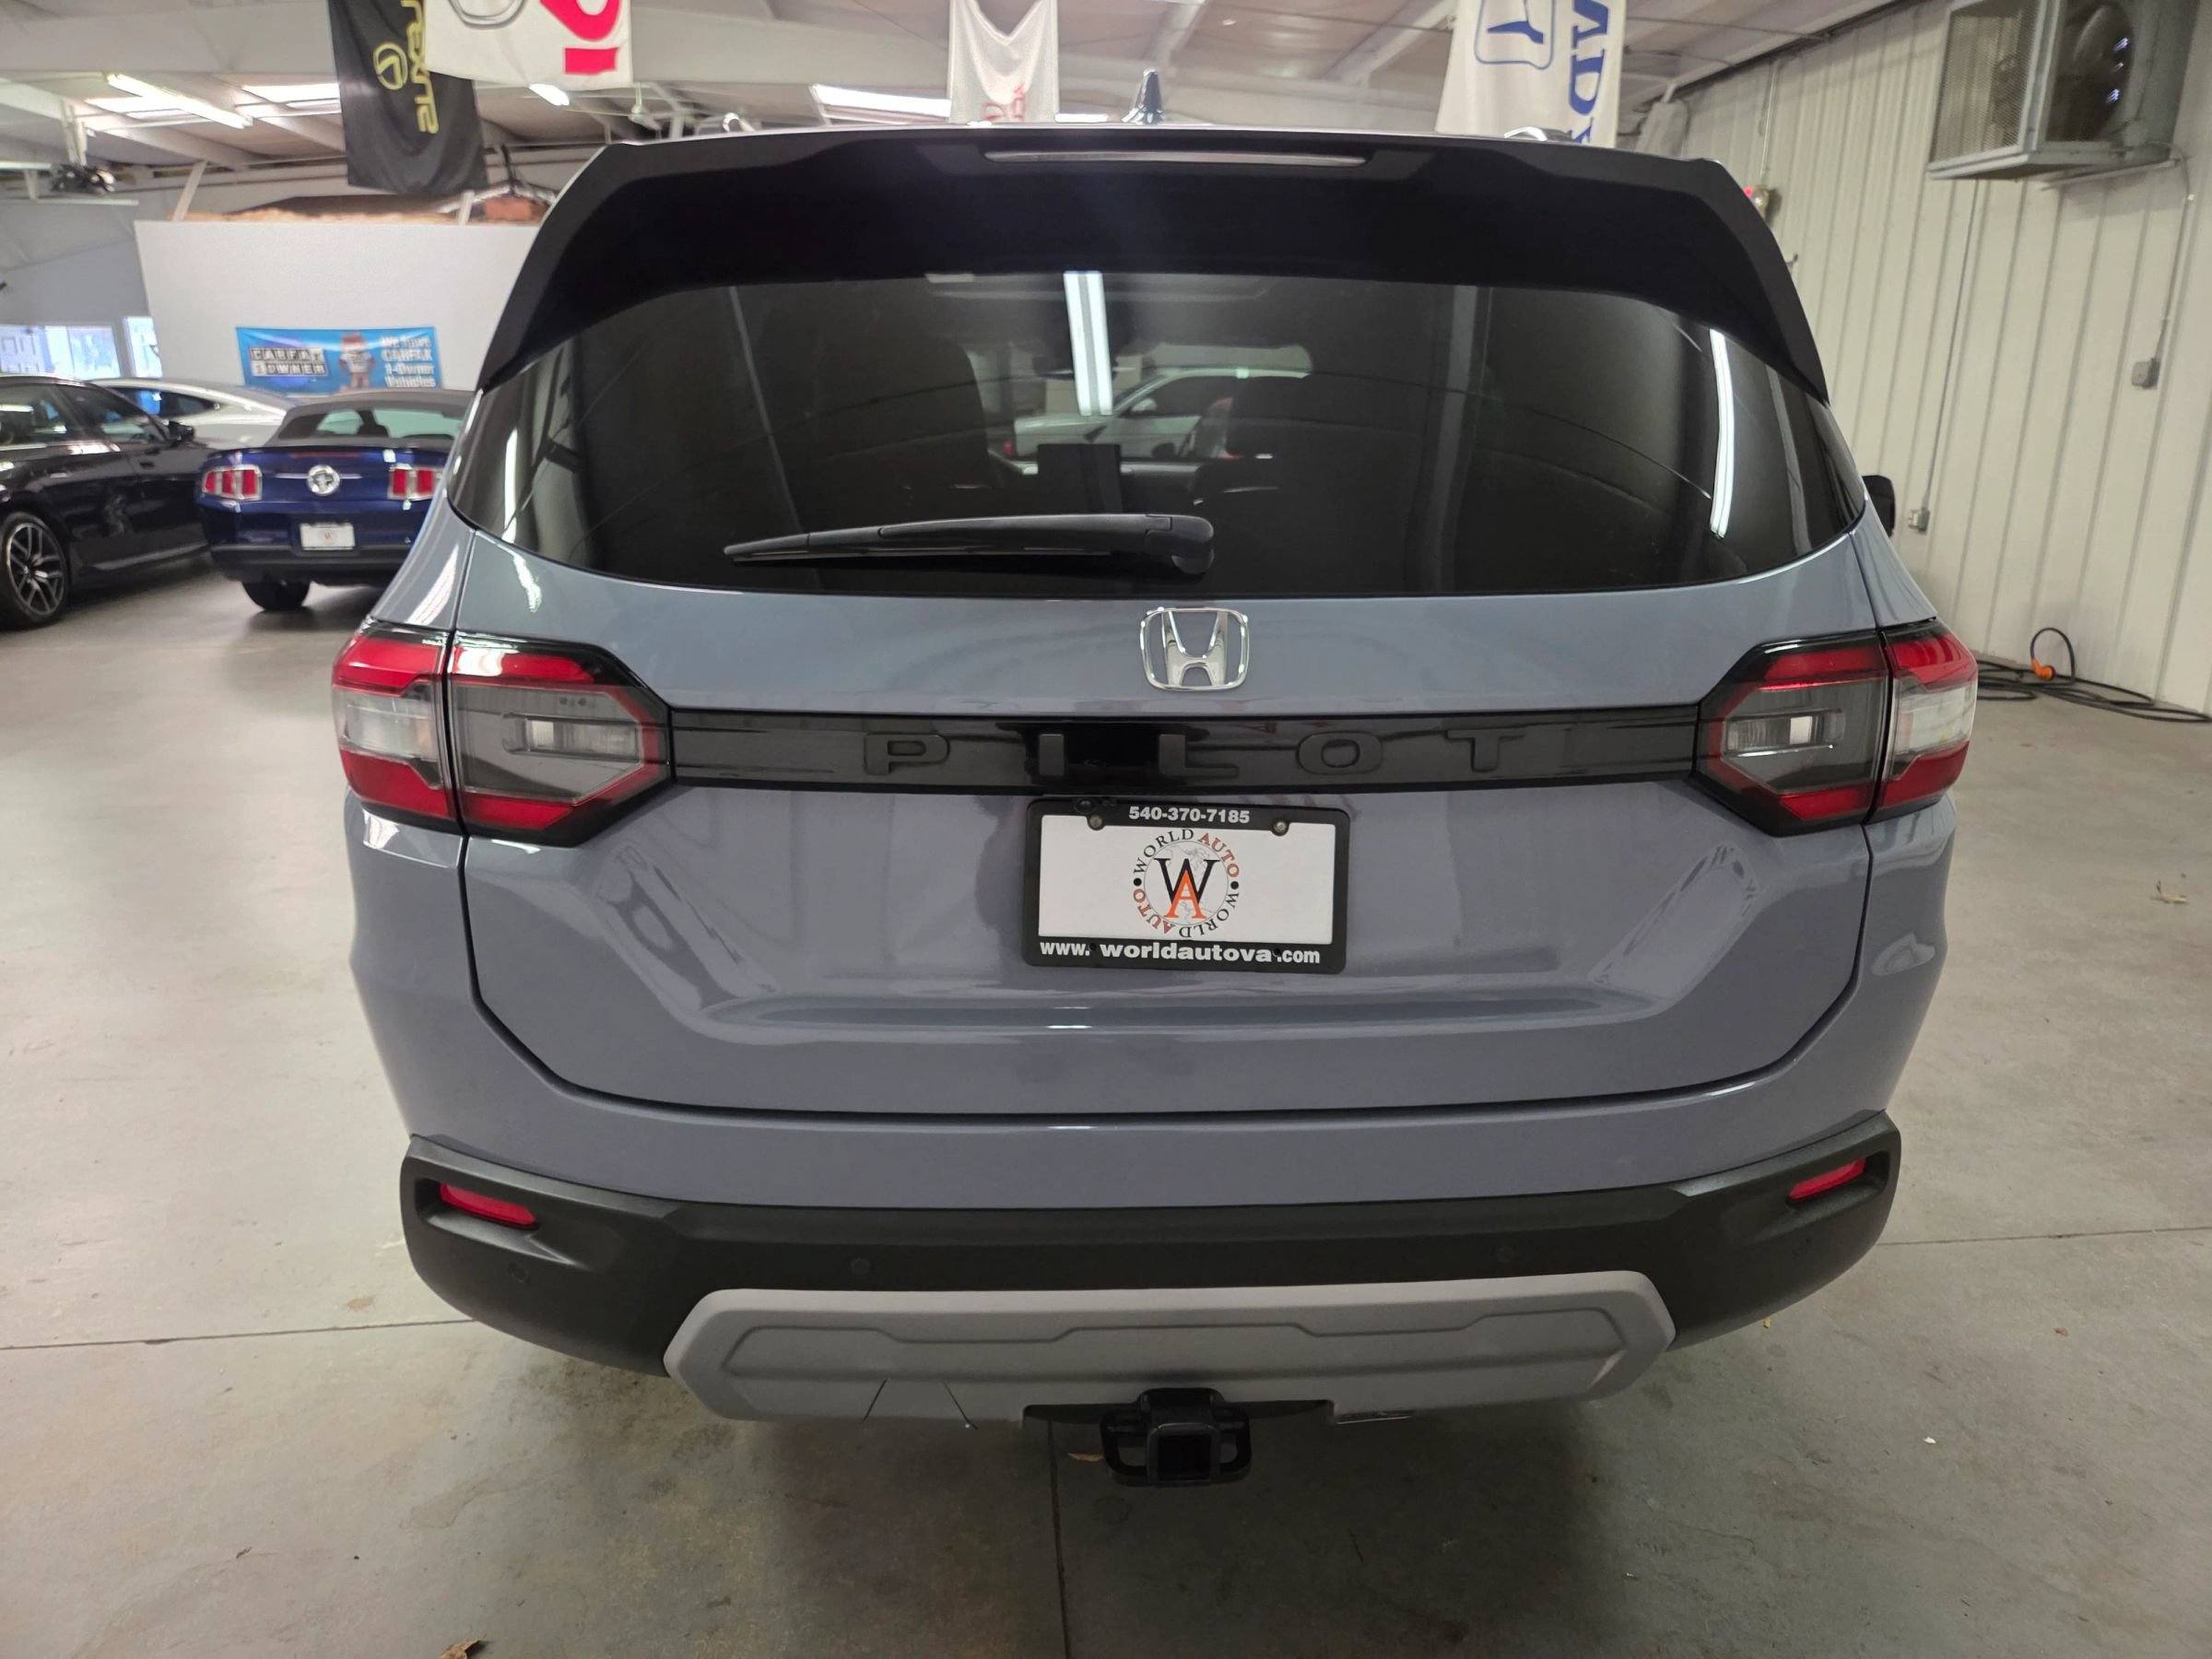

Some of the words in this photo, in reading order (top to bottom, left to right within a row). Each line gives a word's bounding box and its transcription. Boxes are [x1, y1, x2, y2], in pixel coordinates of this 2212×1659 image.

[863, 729, 1527, 776] PILOT
[1128, 806, 1251, 824] 540-370-7185
[1133, 829, 1194, 875] WORLD
[1196, 832, 1241, 878] AUTO
[1133, 888, 1176, 935] AUTO
[1178, 892, 1240, 938] WORLD
